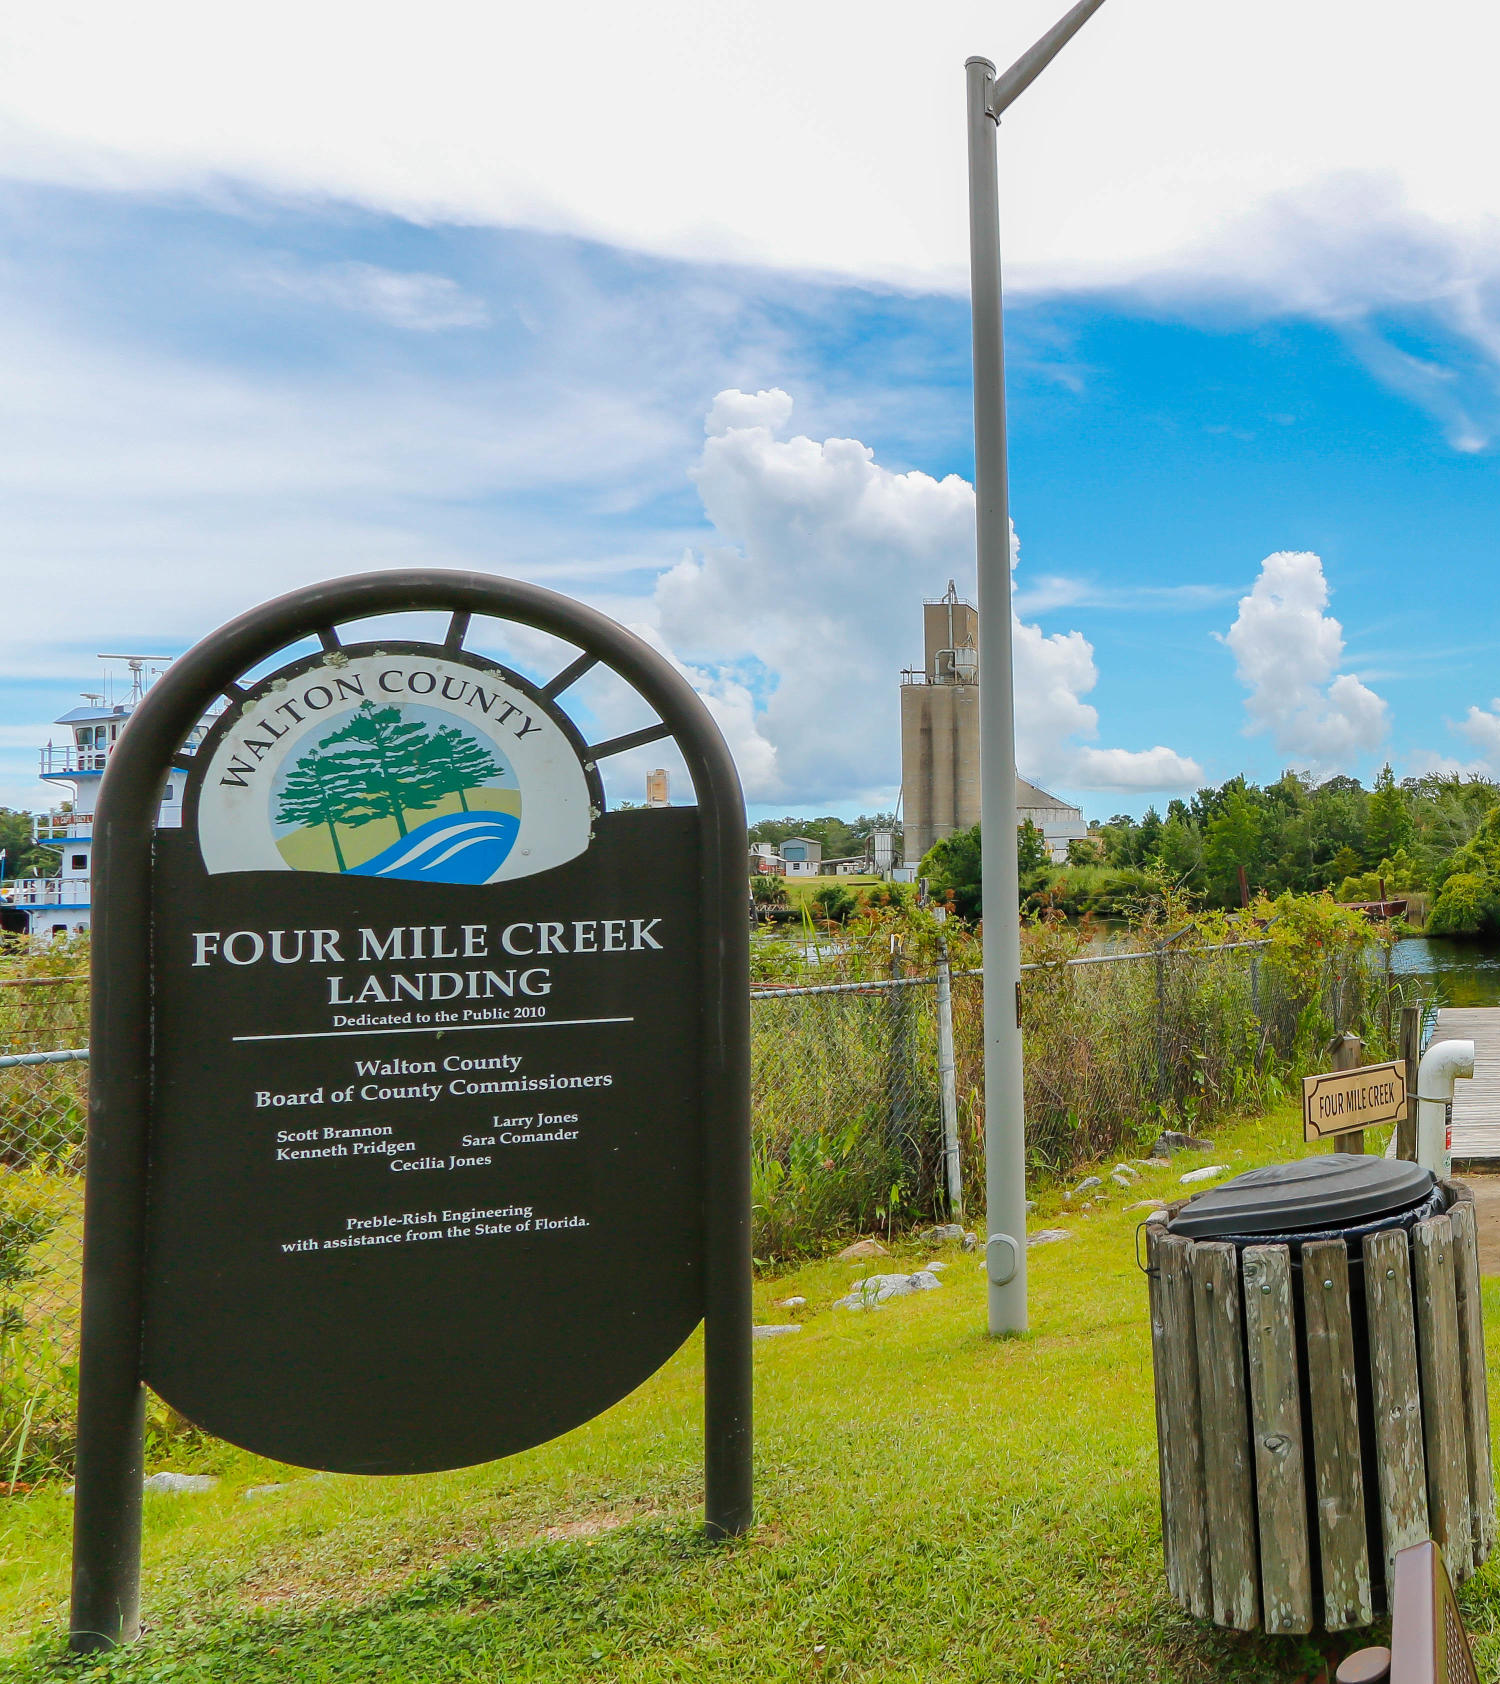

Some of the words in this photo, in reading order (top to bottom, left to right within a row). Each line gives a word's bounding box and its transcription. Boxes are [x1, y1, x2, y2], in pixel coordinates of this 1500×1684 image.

[219, 673, 366, 787] WALTON
[378, 670, 542, 741] COUNTY
[191, 929, 345, 967] FOUR
[358, 924, 489, 961] MILE
[501, 918, 664, 956] CREEK
[326, 968, 552, 1005] LANDING
[333, 1012, 412, 1027] Dedicated
[416, 1013, 431, 1023] to
[435, 1010, 459, 1022] the
[462, 1007, 510, 1021] Public
[513, 1006, 546, 1018] 2010
[354, 1058, 437, 1077] Walton
[443, 1054, 523, 1073] County
[255, 1087, 324, 1108] Board
[330, 1085, 354, 1102] of
[360, 1082, 443, 1102] County
[449, 1073, 613, 1095] Commissioners
[1319, 1092, 1344, 1118] FOUR
[1346, 1087, 1367, 1112] MILE
[1368, 1081, 1395, 1107] CREEK
[492, 1115, 533, 1129] Larry
[537, 1112, 579, 1127] Jones
[276, 1130, 319, 1143] Scott
[322, 1126, 393, 1140] Brannon
[462, 1134, 496, 1147] Sara
[499, 1128, 579, 1144] Comander
[275, 1144, 348, 1161] Kenneth
[352, 1140, 416, 1155] Pridgen
[390, 1157, 445, 1172] Cecilia
[448, 1155, 492, 1170] Jones
[346, 1211, 437, 1230] Preble-Rish
[442, 1205, 533, 1223] Engineering
[281, 1238, 319, 1252] with
[323, 1234, 402, 1249] assistance
[405, 1229, 443, 1241] from
[447, 1226, 471, 1238] the
[475, 1222, 512, 1235] State
[516, 1219, 531, 1232] of
[535, 1215, 590, 1230] Florida.
